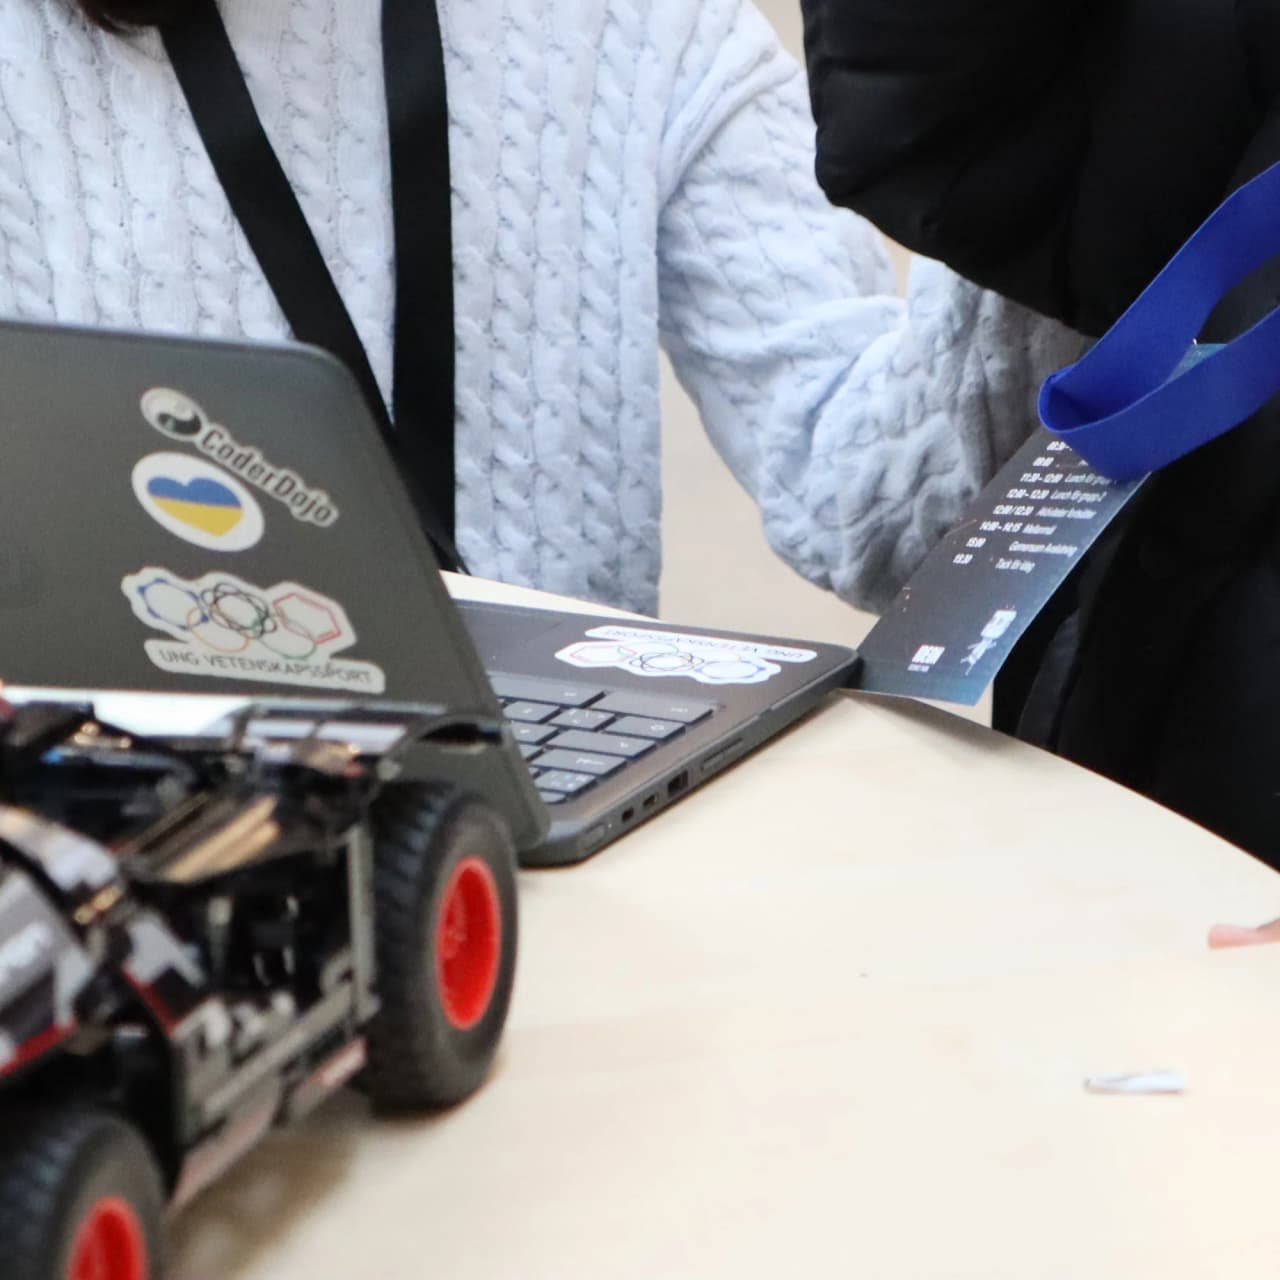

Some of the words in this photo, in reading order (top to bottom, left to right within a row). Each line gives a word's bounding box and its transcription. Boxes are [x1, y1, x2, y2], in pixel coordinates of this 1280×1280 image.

[201, 428, 332, 522] CoderDojo
[158, 648, 200, 666] UNG
[203, 654, 376, 683] VETENSKAPSSPORT
